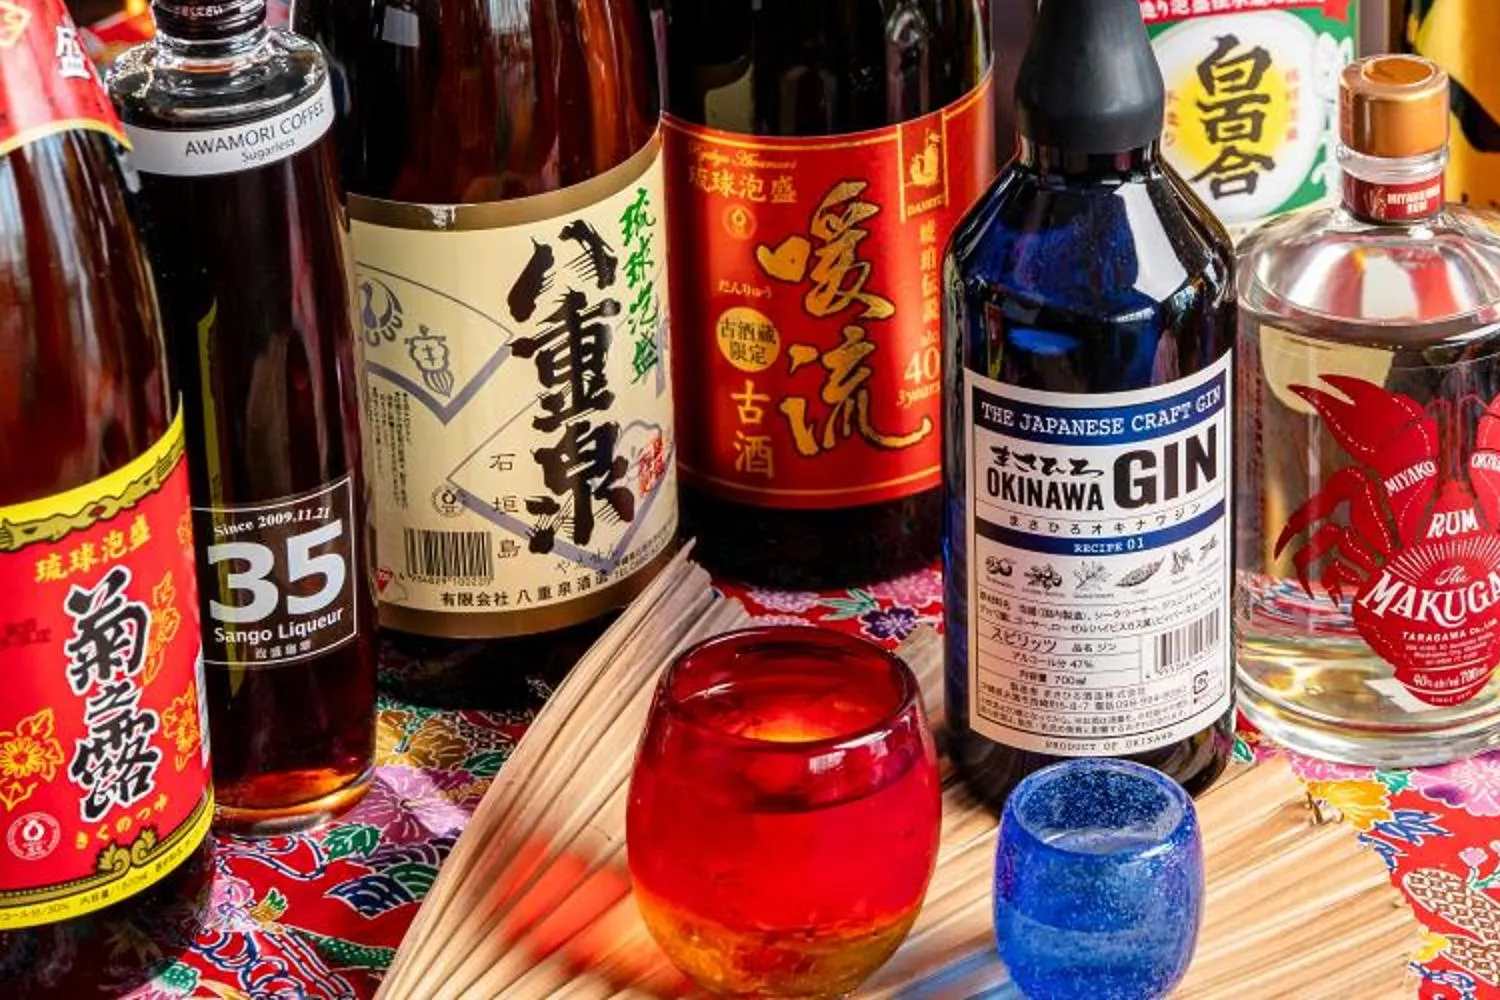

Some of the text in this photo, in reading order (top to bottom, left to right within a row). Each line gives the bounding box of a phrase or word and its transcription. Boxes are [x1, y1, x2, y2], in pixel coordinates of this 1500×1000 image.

[184, 102, 326, 158] AWAMORI COFFEE
[1188, 33, 1276, 201] 白百合
[240, 137, 296, 164] Sugarless
[719, 319, 777, 346] 古酒蔵
[757, 181, 932, 456] 暖流
[729, 341, 769, 365] 限定
[507, 219, 635, 554] 八重泉
[730, 380, 775, 479] 古酒
[981, 386, 1222, 437] THE JAPANESE CRAFT GIN
[1113, 423, 1218, 510] GIN
[1383, 460, 1437, 498] MIYAKO
[488, 453, 522, 559] 石垣島
[986, 467, 1105, 511] OKINAWA
[213, 506, 330, 537] Since 2009.11.21
[1426, 507, 1479, 539] RUM
[35, 514, 152, 584] 琉球泡盛
[1073, 537, 1145, 554] RECIPE 01
[207, 518, 346, 624] 35
[440, 590, 509, 607] 有限会社
[213, 607, 345, 646] Sango Liqueur
[990, 626, 1058, 653] スピリッツ
[1402, 629, 1467, 642] TARAGAWA
[65, 568, 161, 821] 菊之露
[1045, 740, 1096, 751] PRODUCT
[1102, 740, 1118, 751] OF
